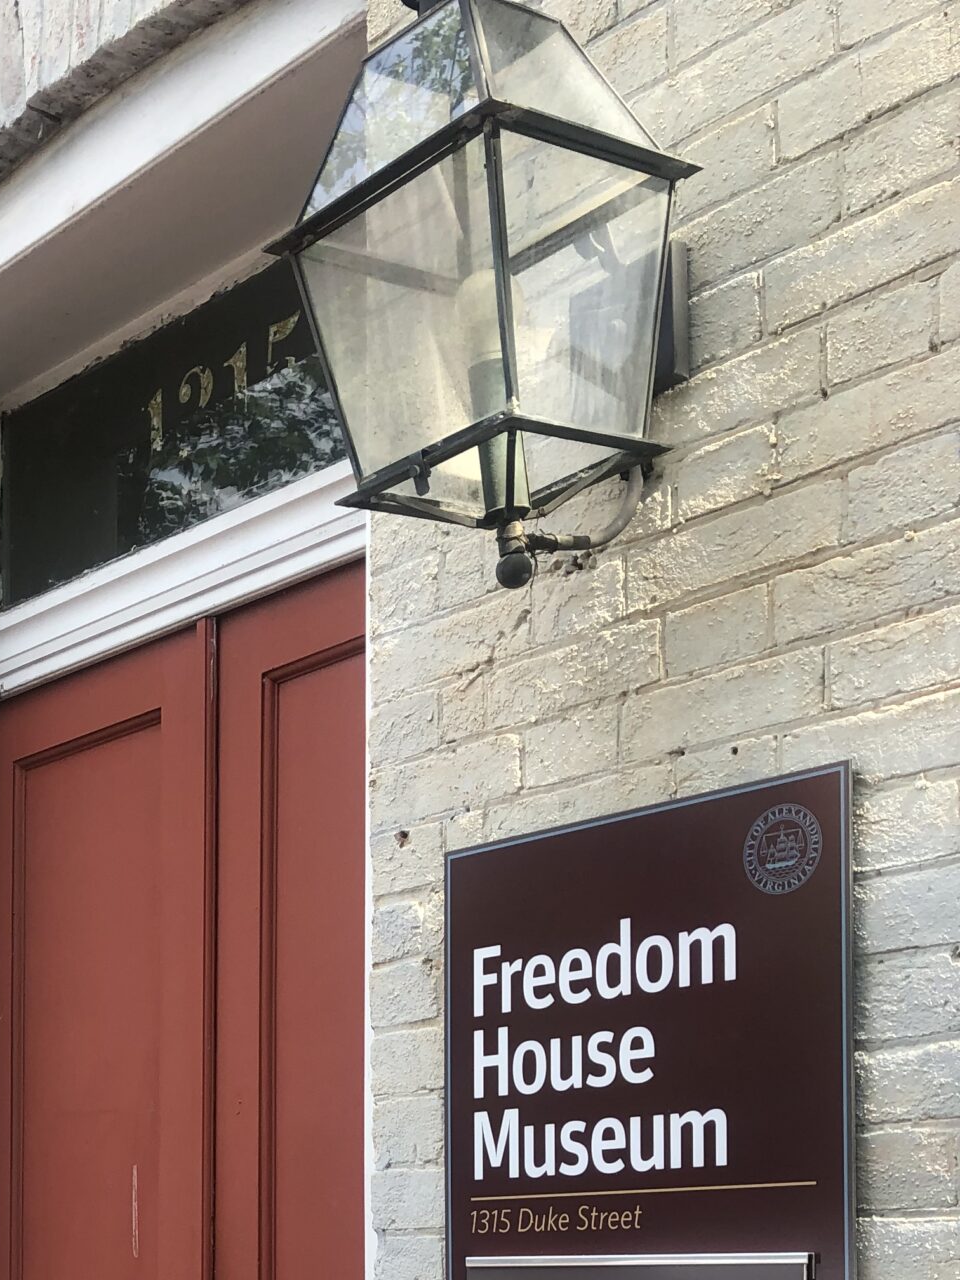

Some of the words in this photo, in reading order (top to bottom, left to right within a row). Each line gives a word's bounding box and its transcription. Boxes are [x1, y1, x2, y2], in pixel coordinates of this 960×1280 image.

[752, 819, 767, 837] OF
[767, 806, 820, 858] ALEXANDRIA
[753, 864, 813, 892] VIRGINIA
[472, 917, 738, 1019] Freedom
[472, 1025, 657, 1100] House
[472, 1106, 729, 1182] Museum
[469, 1208, 512, 1235] 1315
[517, 1206, 571, 1233] Duke
[576, 1204, 643, 1231] Street
